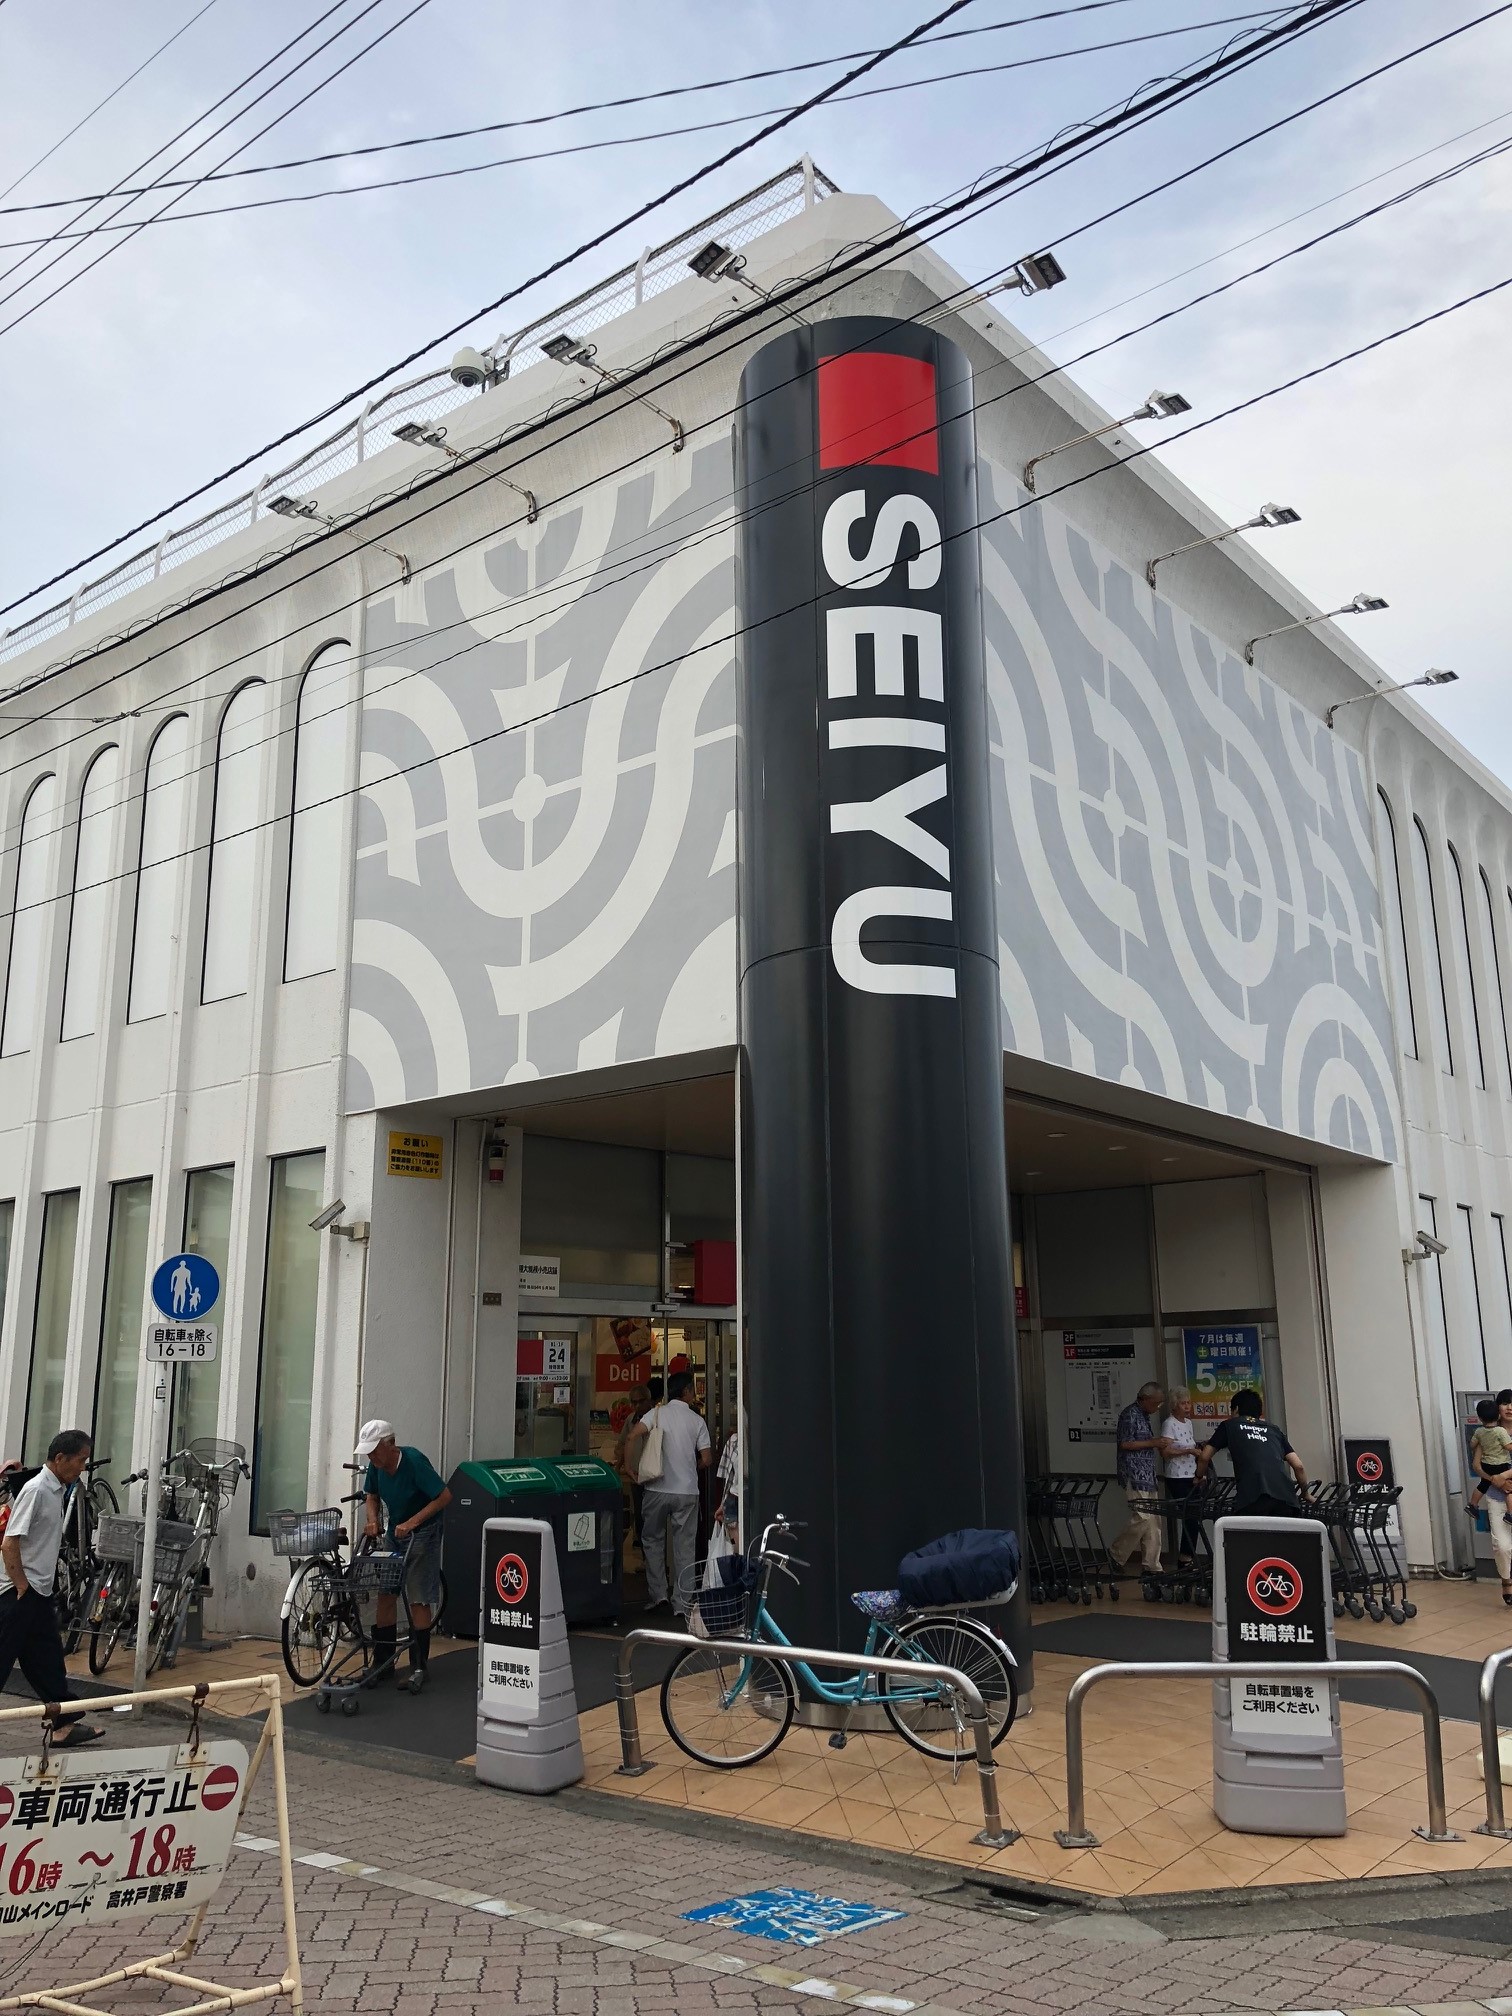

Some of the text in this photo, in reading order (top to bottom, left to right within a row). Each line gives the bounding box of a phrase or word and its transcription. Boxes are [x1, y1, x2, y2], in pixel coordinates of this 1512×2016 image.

[821, 489, 956, 998] SEIYU
[403, 1137, 429, 1148] お願い
[154, 1328, 213, 1342] 自転車を除く
[1064, 1333, 1075, 1342] 2F
[1200, 1333, 1244, 1344] 7月は毎週
[158, 1343, 206, 1357] 16-18
[549, 1348, 565, 1363] 24
[1065, 1348, 1076, 1357] 1F
[609, 1363, 640, 1382] Deli
[1239, 1424, 1268, 1433] Happy
[1247, 1432, 1268, 1443] Help
[490, 1608, 533, 1629] 駐輪禁止
[1240, 1622, 1315, 1643] 駐輪禁止
[490, 1660, 531, 1676] 自転車置場を
[488, 1673, 534, 1689] ご利用ください
[1246, 1683, 1315, 1698] 自転車置場を
[1242, 1699, 1320, 1714] ご利用ください
[11, 1772, 199, 1831] 車両通行止
[106, 1880, 189, 1910] 高井戸警察署
